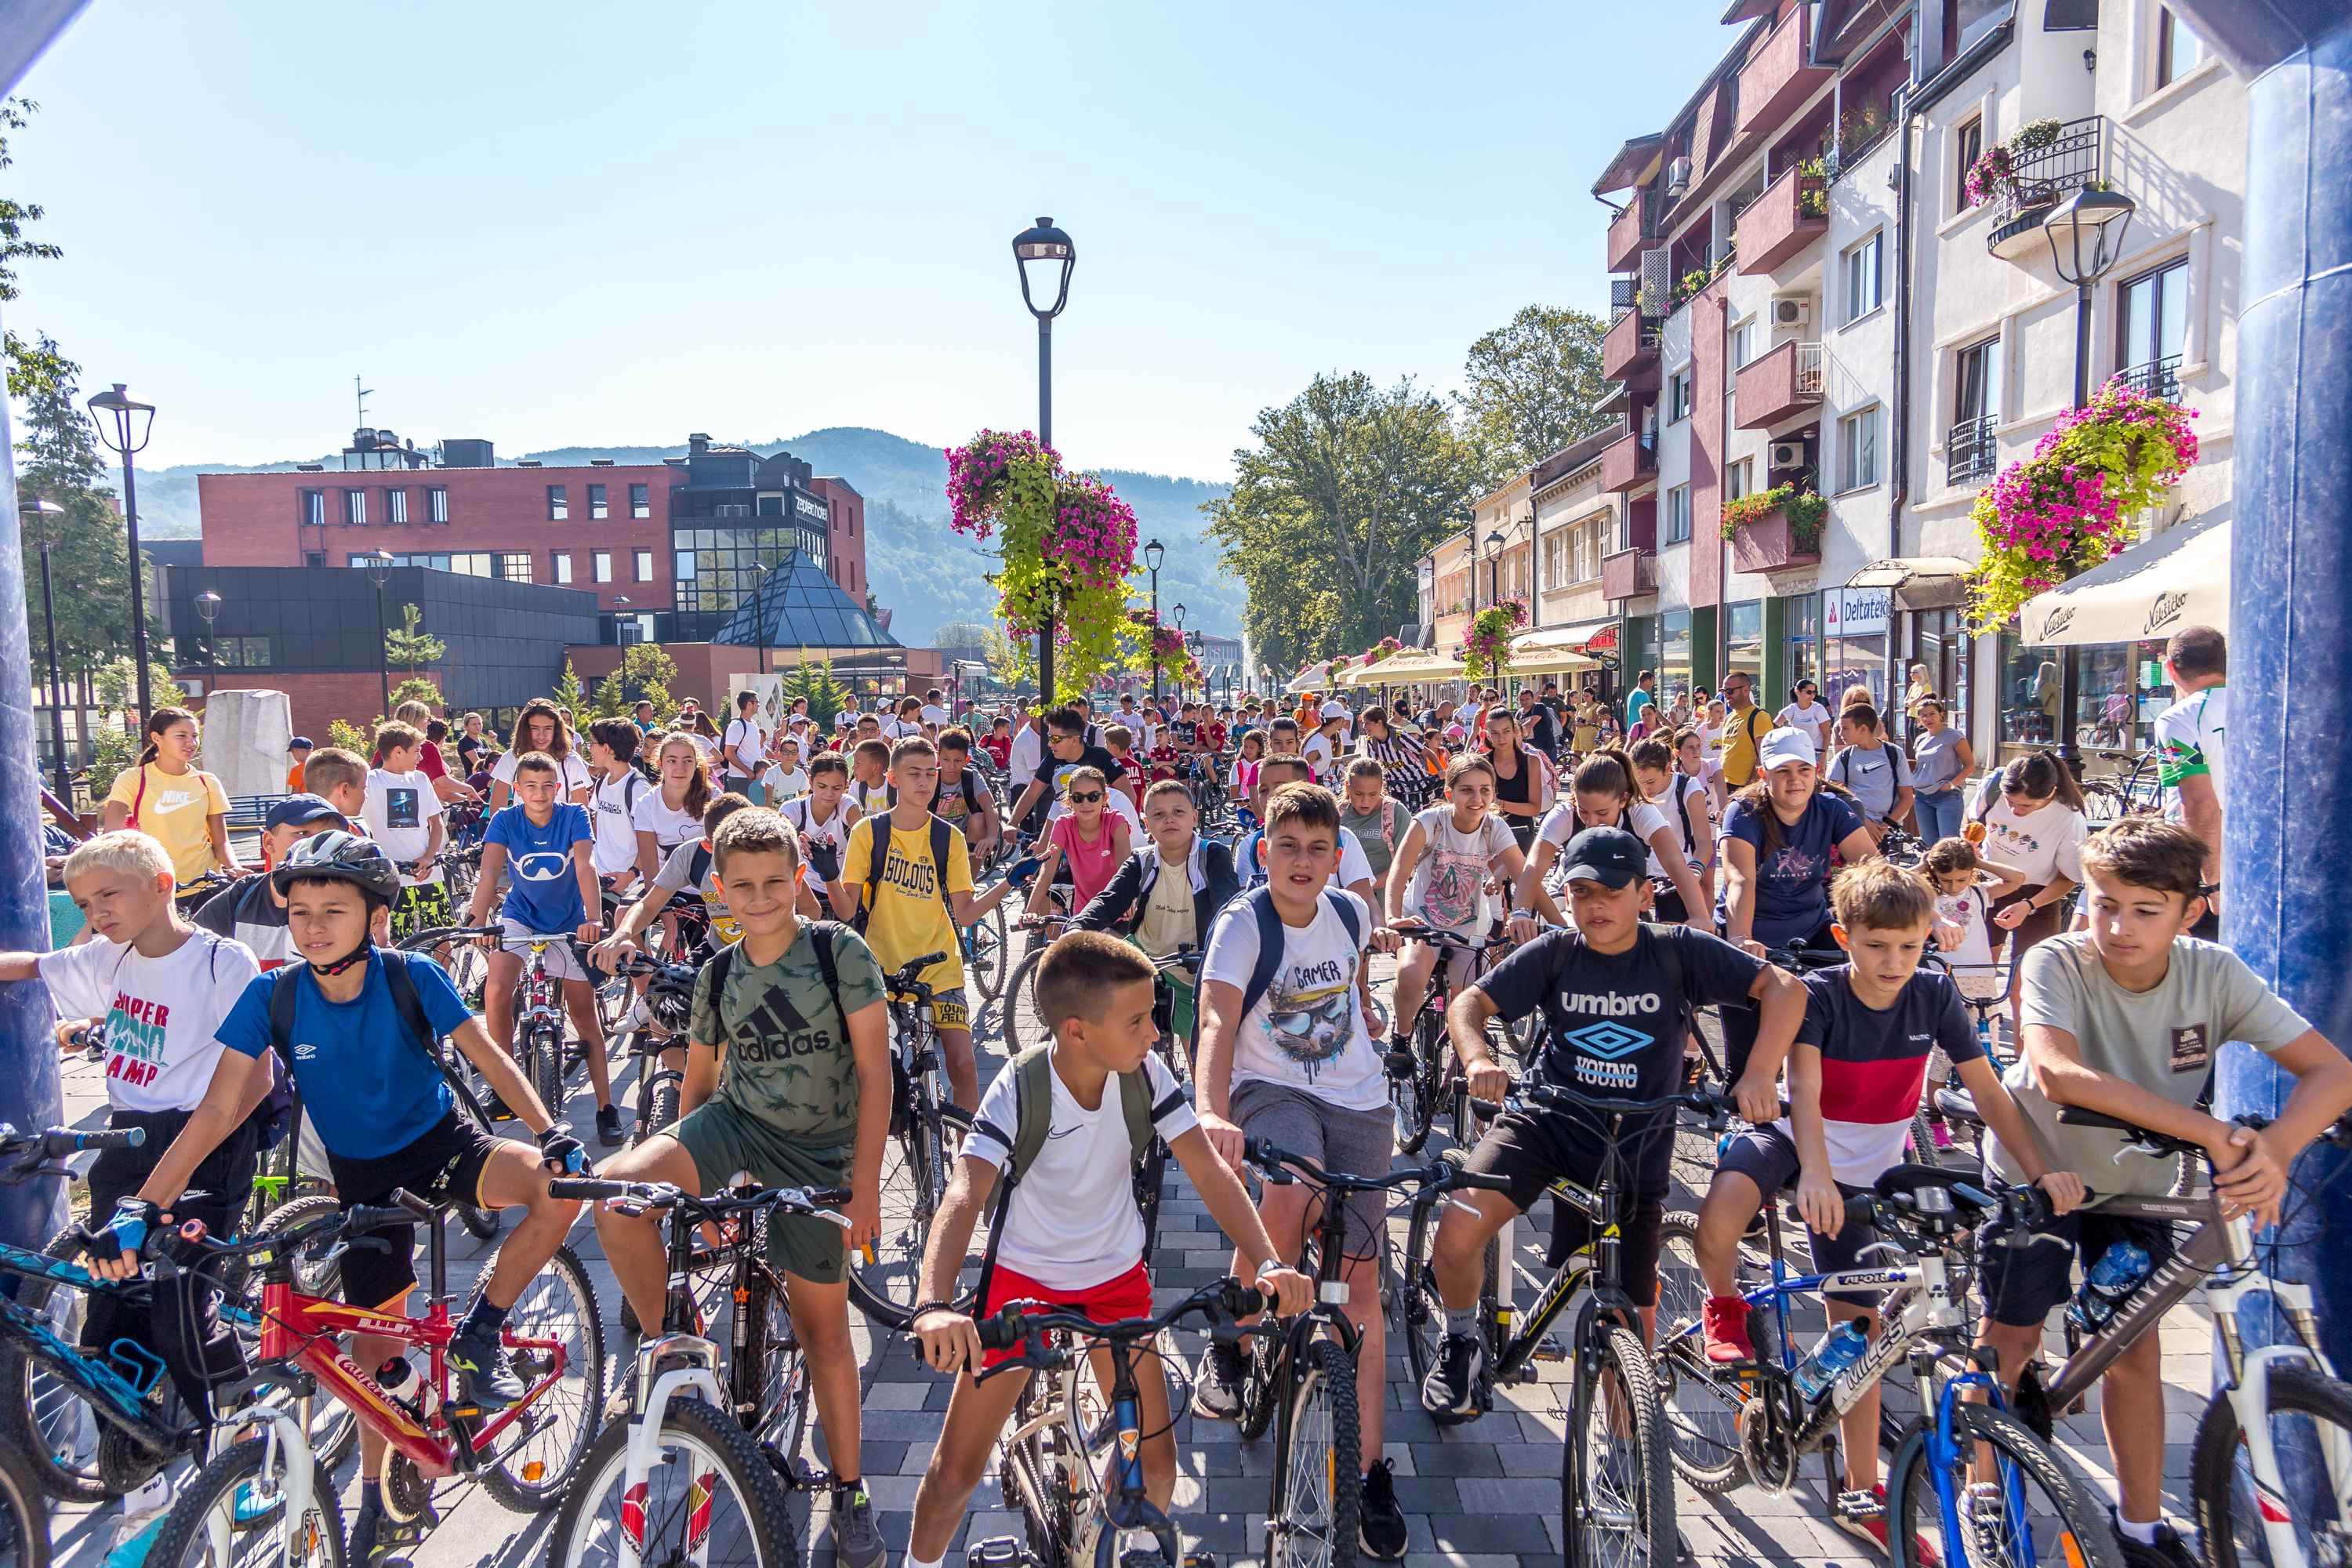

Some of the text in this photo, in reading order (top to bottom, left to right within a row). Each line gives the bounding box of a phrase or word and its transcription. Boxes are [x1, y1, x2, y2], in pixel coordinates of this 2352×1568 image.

[162, 789, 191, 804] NIKE
[1561, 990, 1661, 1016] umbro
[738, 1028, 831, 1063] adidas
[1574, 1054, 1639, 1090] YOUNG
[1846, 1314, 1906, 1391] MILES
